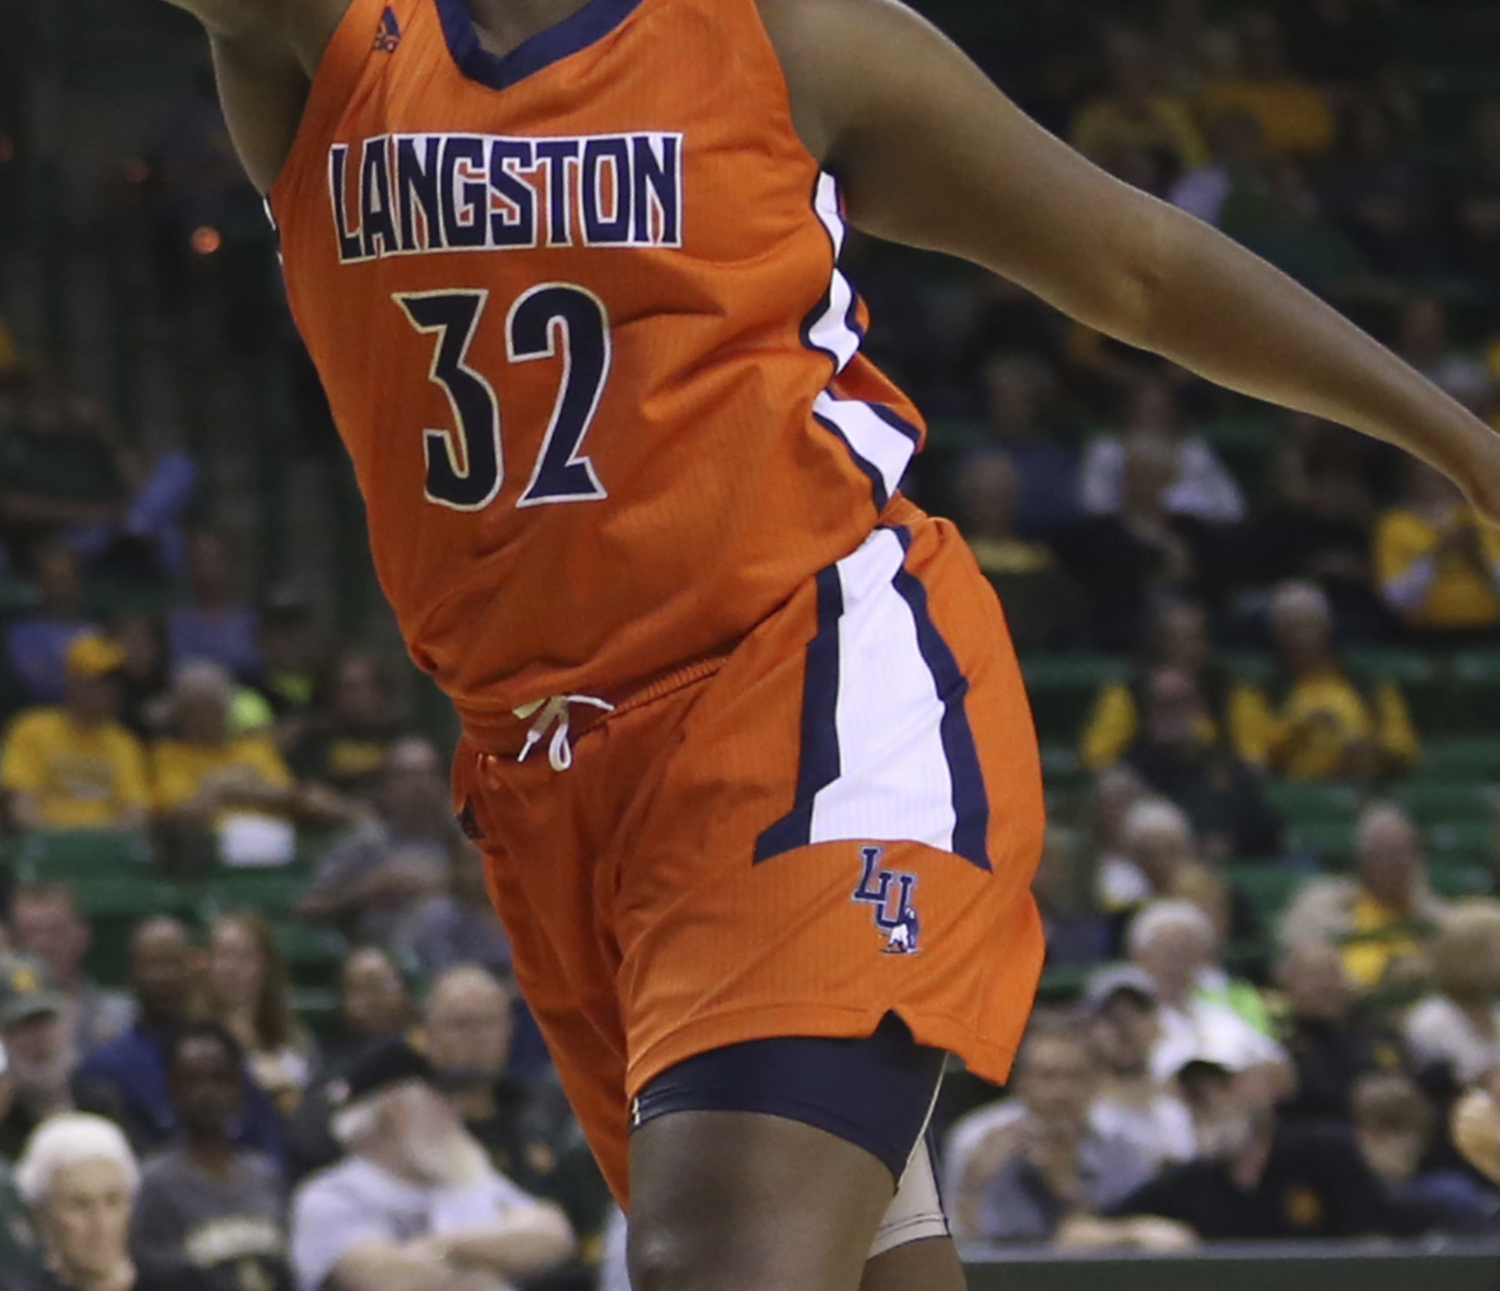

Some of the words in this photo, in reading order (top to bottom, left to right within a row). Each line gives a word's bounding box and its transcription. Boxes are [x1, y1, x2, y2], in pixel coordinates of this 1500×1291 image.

[328, 131, 684, 265] LANGSTON
[390, 281, 612, 512] 32
[851, 846, 918, 933] LU
